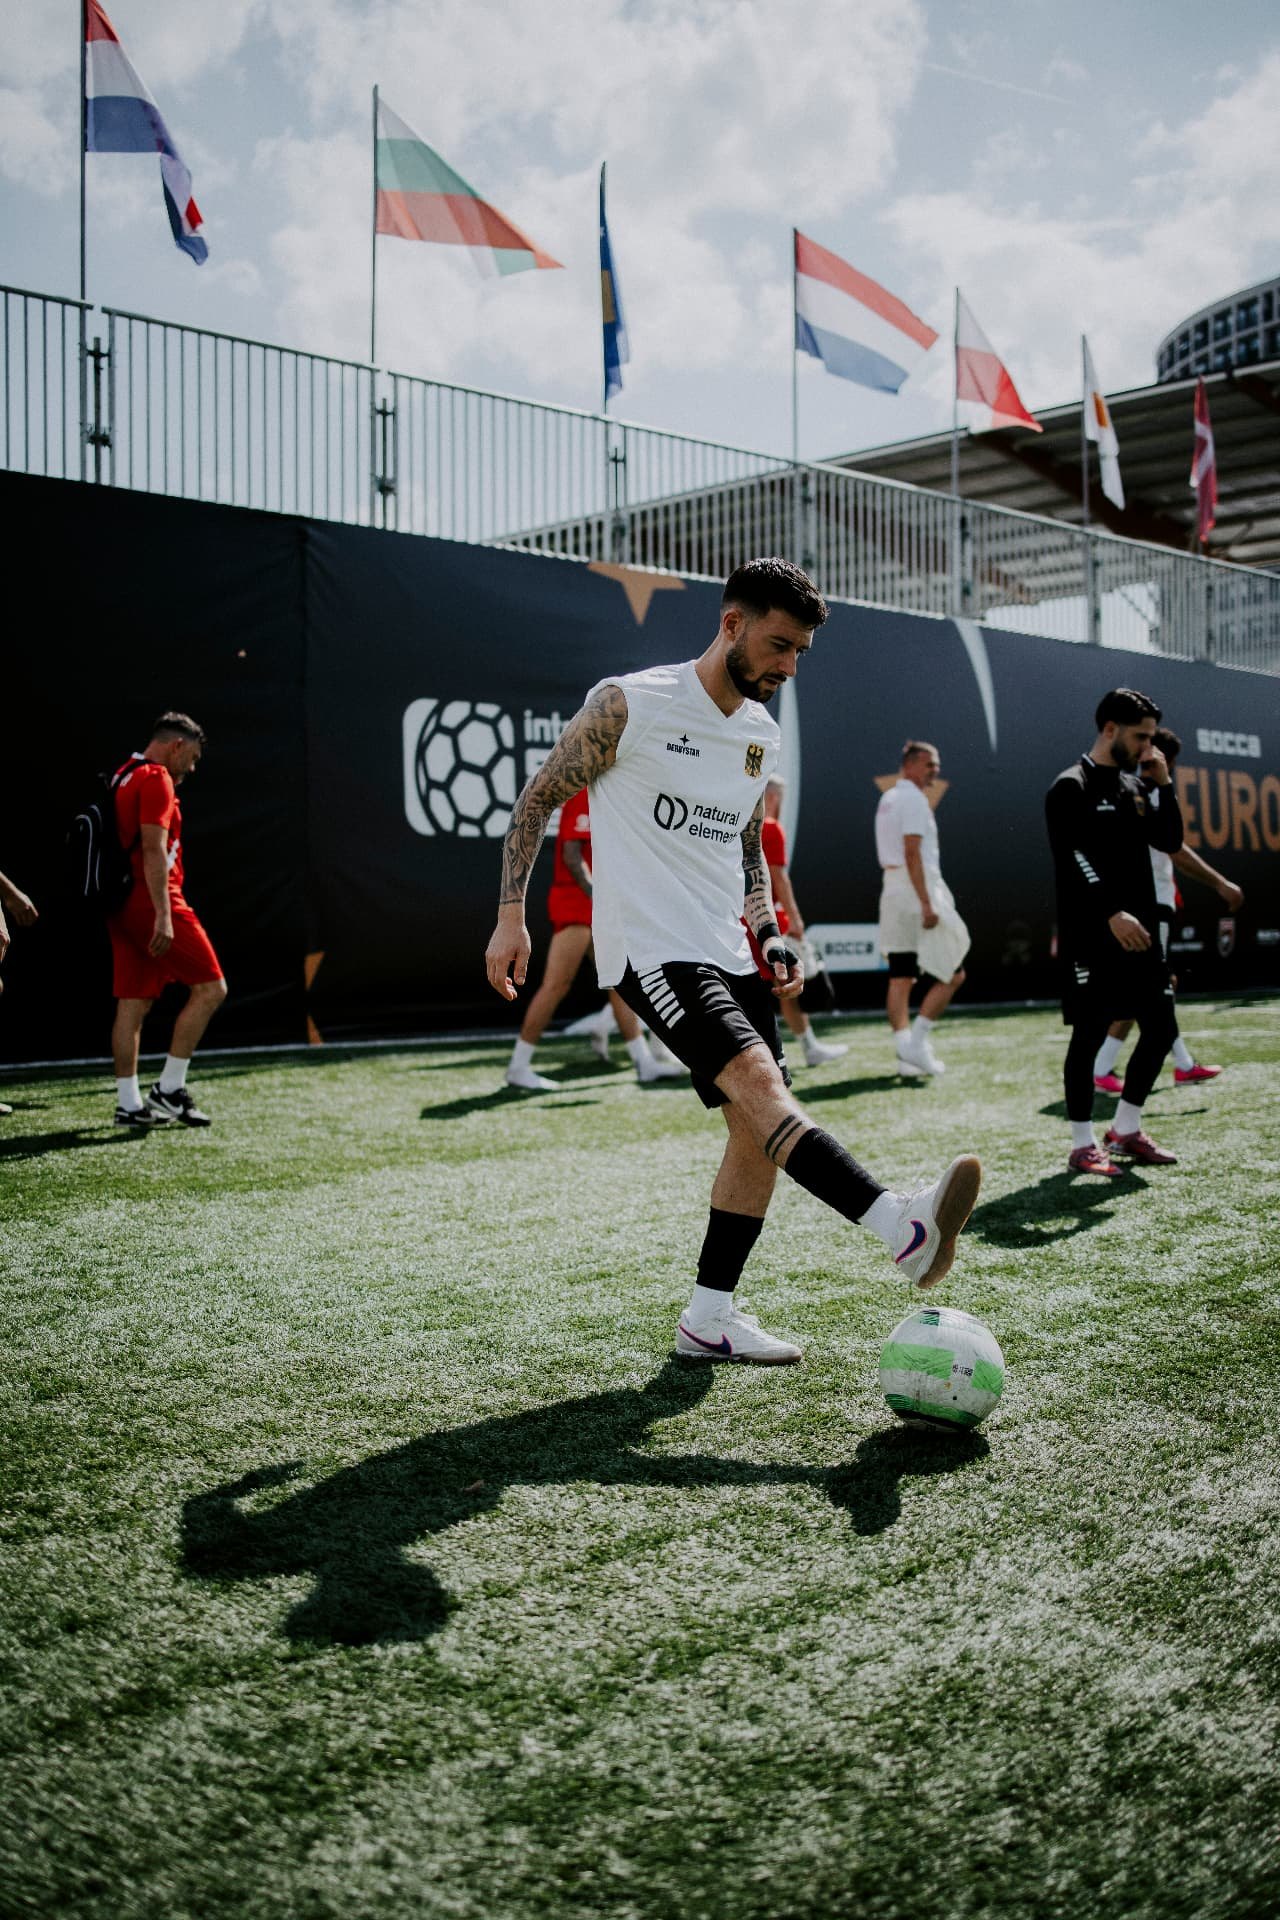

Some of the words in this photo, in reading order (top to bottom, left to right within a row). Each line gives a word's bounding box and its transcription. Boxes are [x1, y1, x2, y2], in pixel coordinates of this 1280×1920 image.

[524, 709, 569, 742] int
[666, 742, 700, 758] DERBYSTAR
[692, 804, 740, 826] natural
[1176, 766, 1280, 852] EURO
